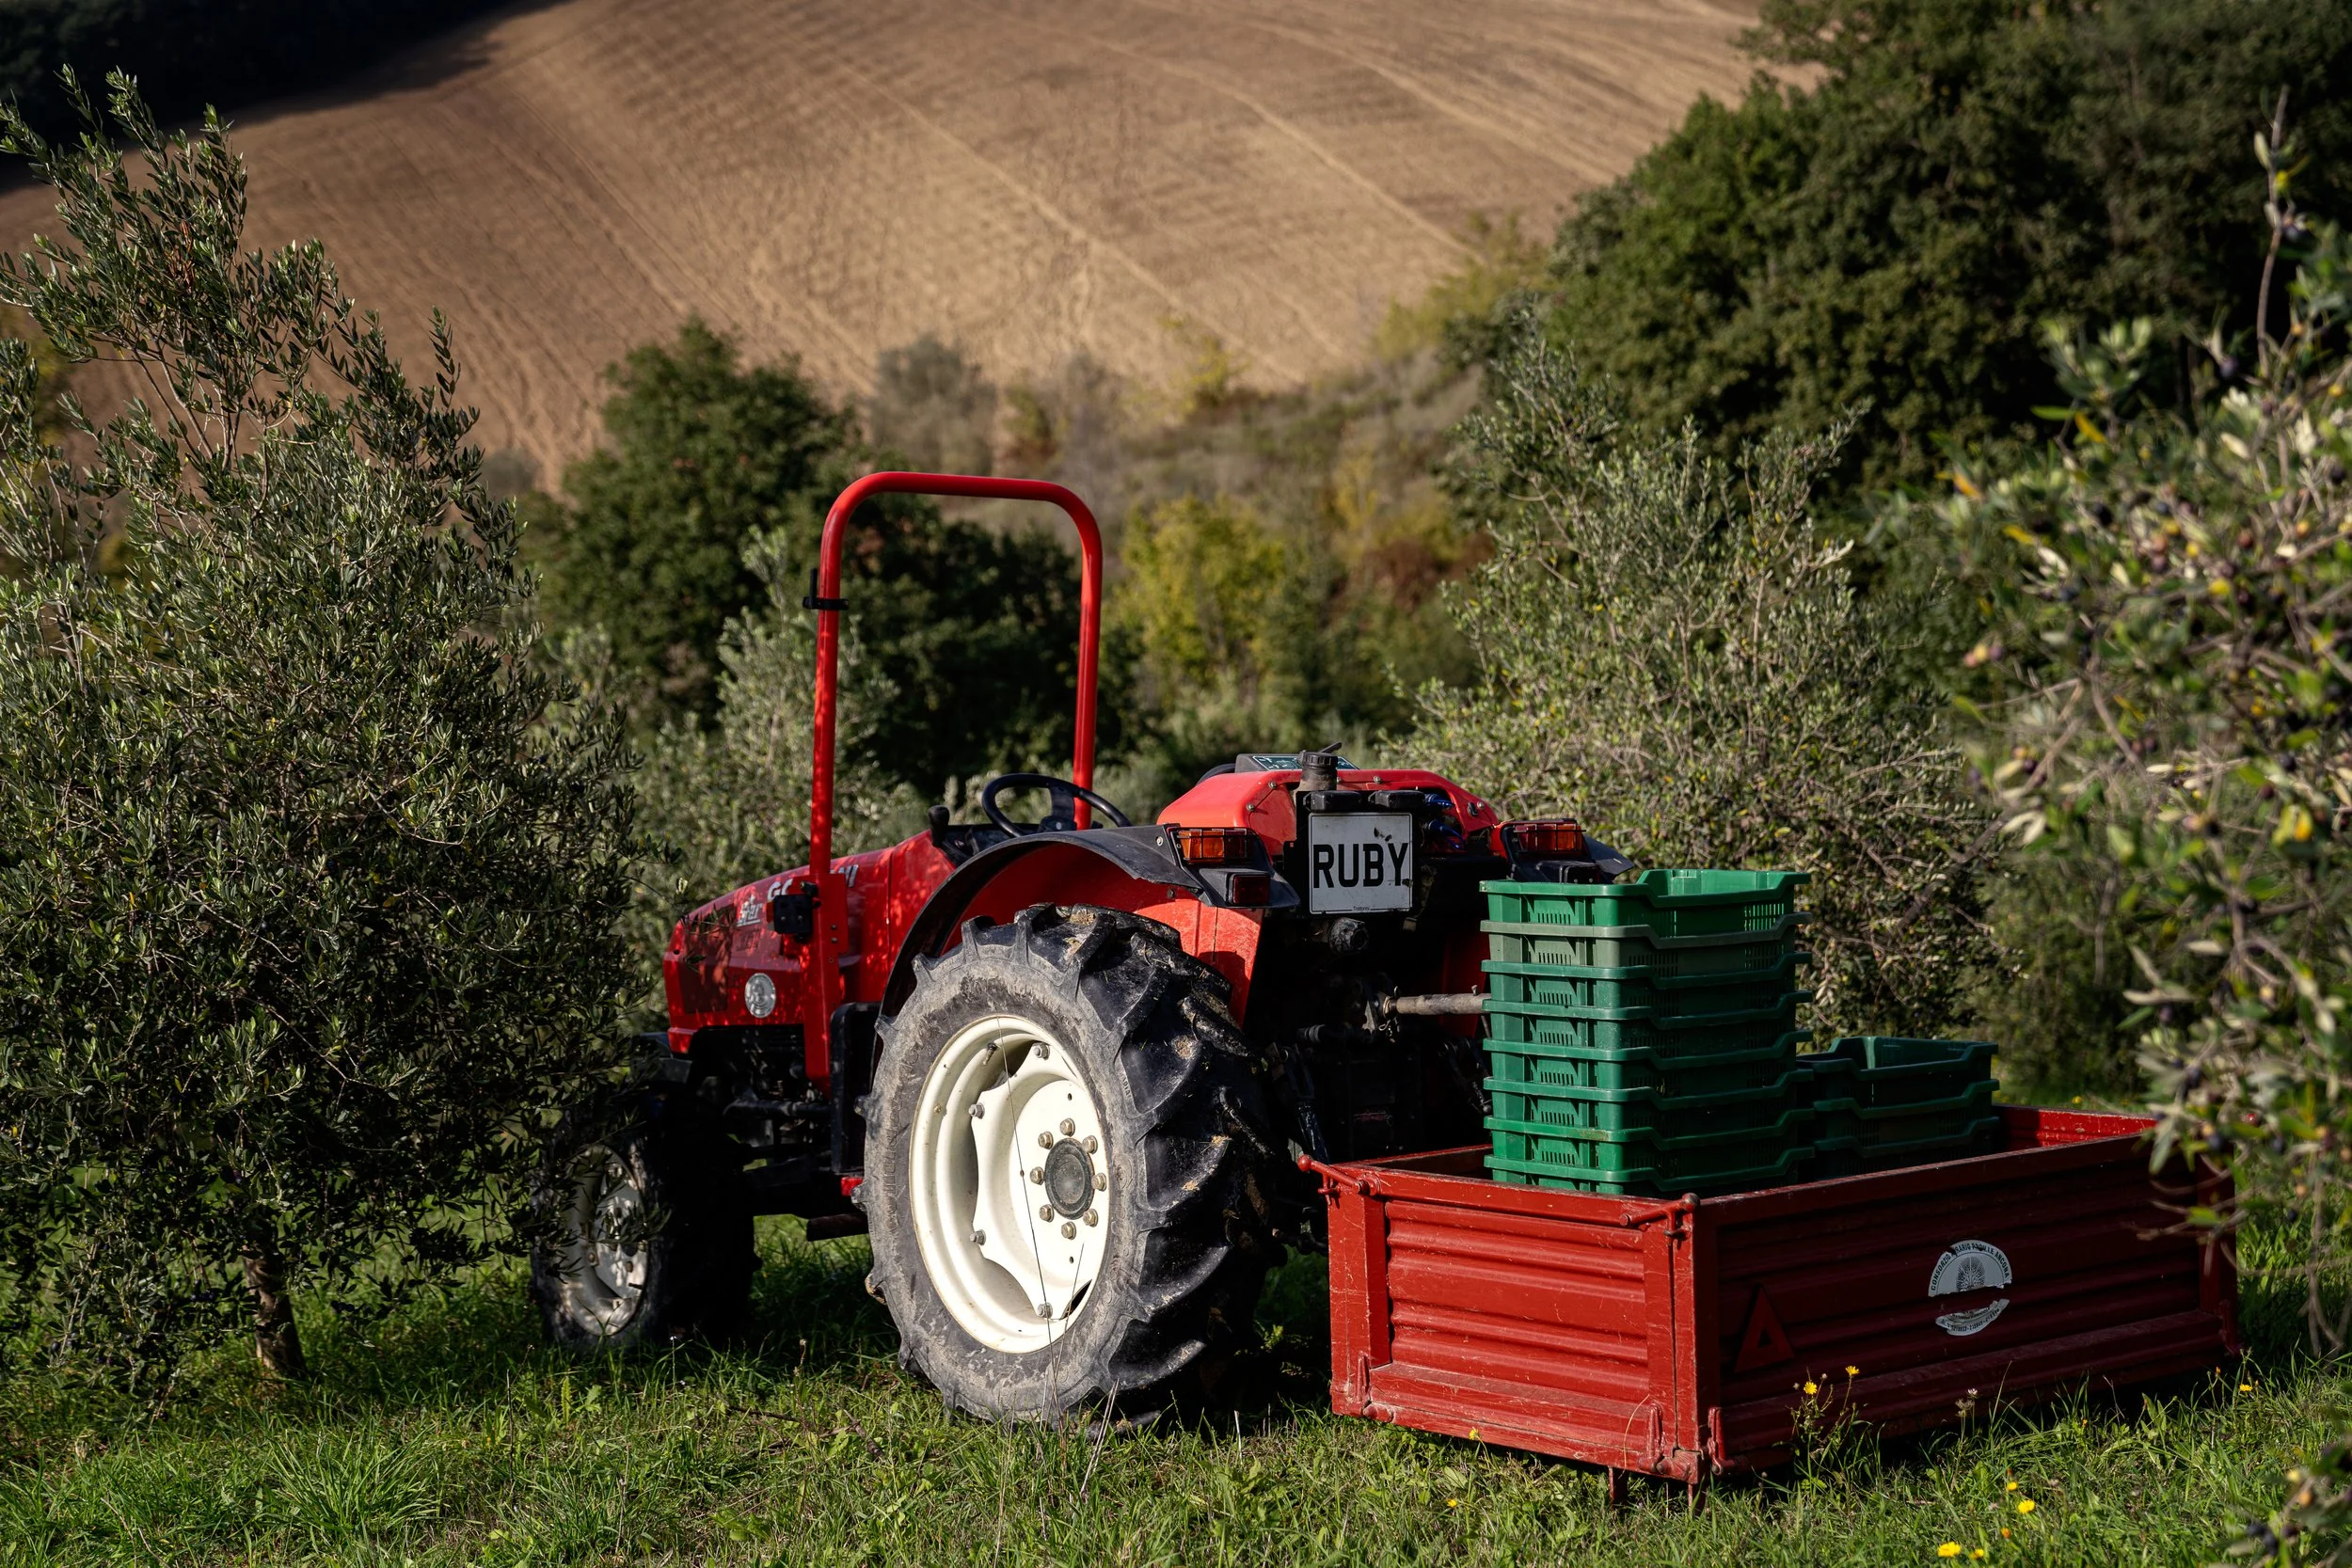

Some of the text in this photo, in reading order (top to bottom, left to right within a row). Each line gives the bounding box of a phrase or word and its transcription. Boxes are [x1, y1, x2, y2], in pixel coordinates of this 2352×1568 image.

[1312, 843, 1409, 889] RUBY
[1931, 1254, 1951, 1291] CONSORZIO
[1994, 1251, 2010, 1278] ANCONA
